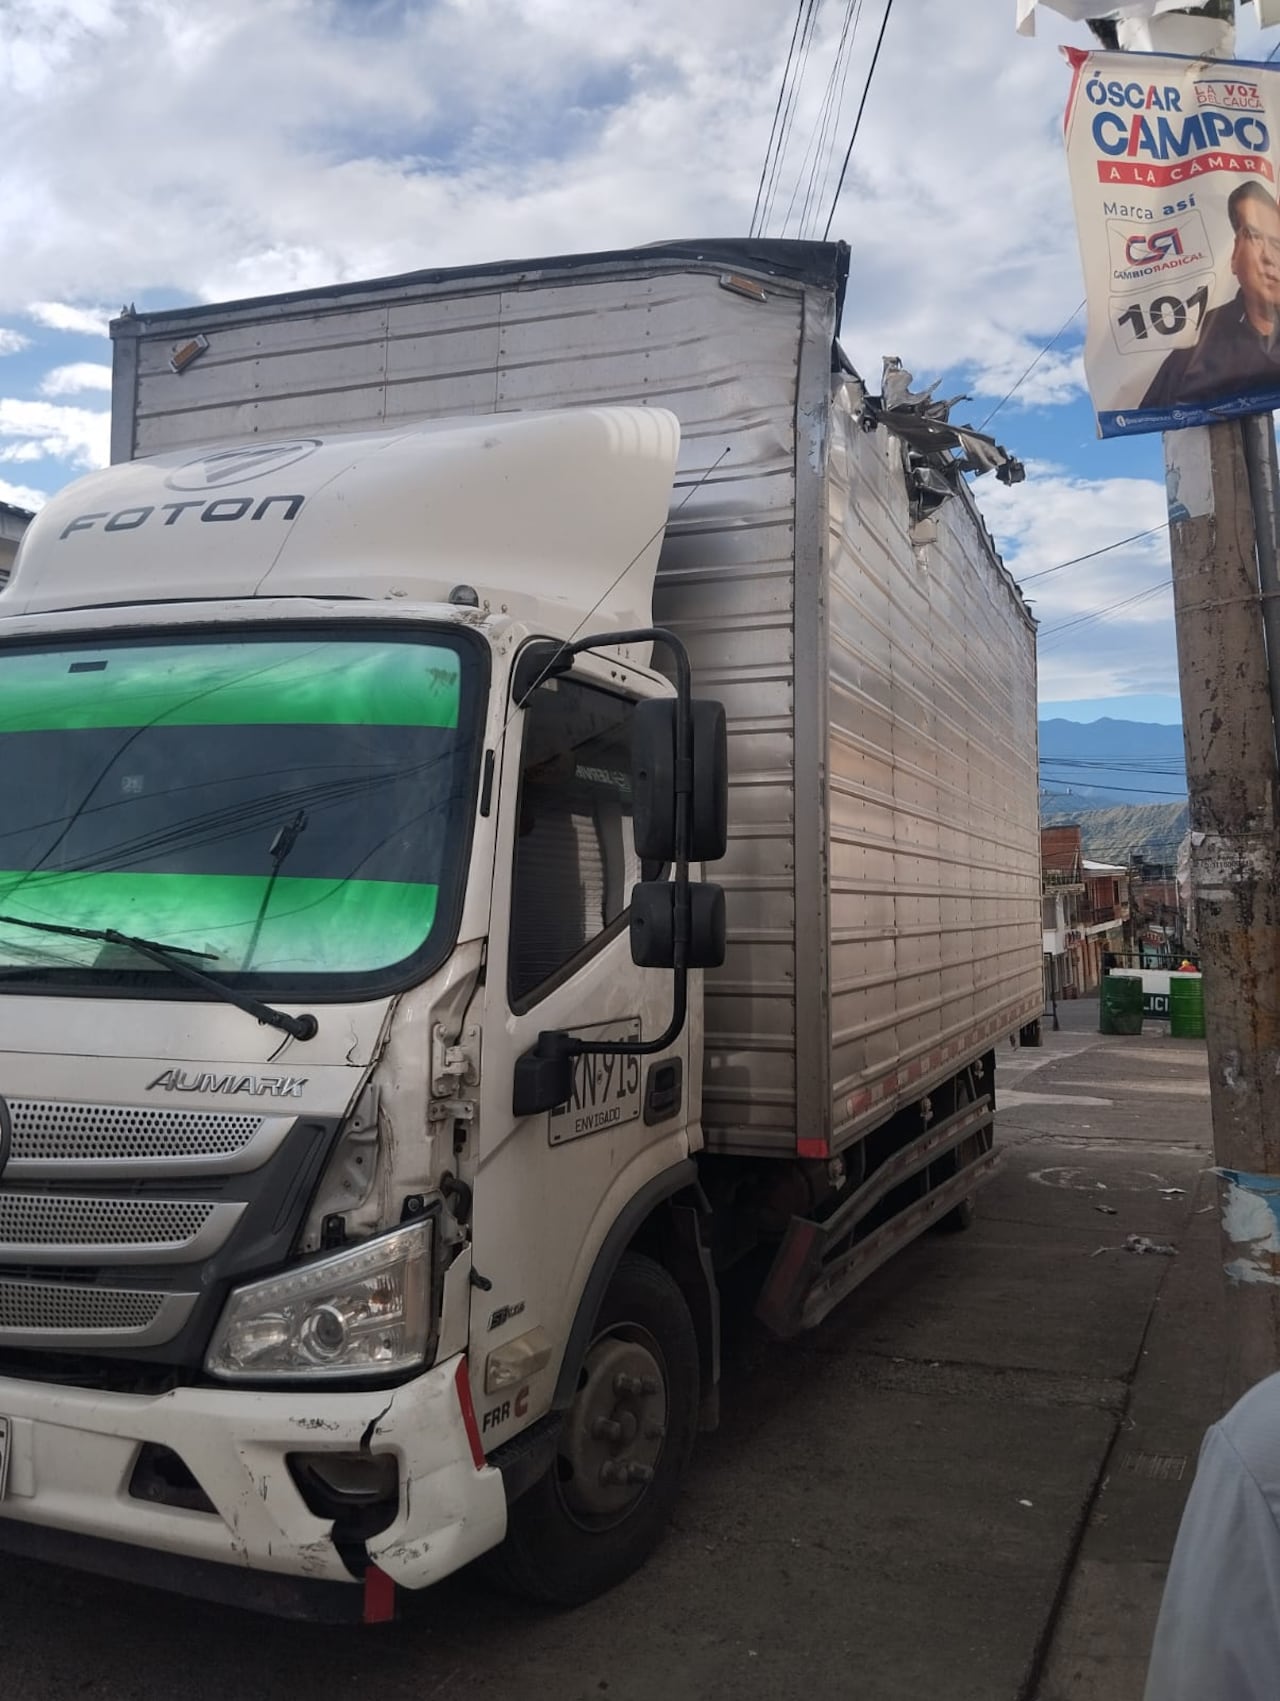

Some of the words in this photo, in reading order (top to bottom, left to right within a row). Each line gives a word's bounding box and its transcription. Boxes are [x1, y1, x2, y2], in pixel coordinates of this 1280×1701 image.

[1086, 71, 1183, 112] ÓSCAR
[1195, 84, 1215, 96] LA
[1224, 84, 1260, 99] VOZ
[1196, 95, 1221, 104] DEL
[1224, 96, 1265, 109] CAUCA
[1092, 111, 1271, 160] CAMPO
[1109, 167, 1121, 180] A
[1134, 168, 1156, 183] LA
[1170, 156, 1267, 180] CÁMARA
[1103, 202, 1154, 220] Marca
[1163, 193, 1197, 216] así
[59, 494, 306, 540] FOTON
[145, 1068, 309, 1098] AUMARK
[575, 1107, 621, 1133] ENVIGADO
